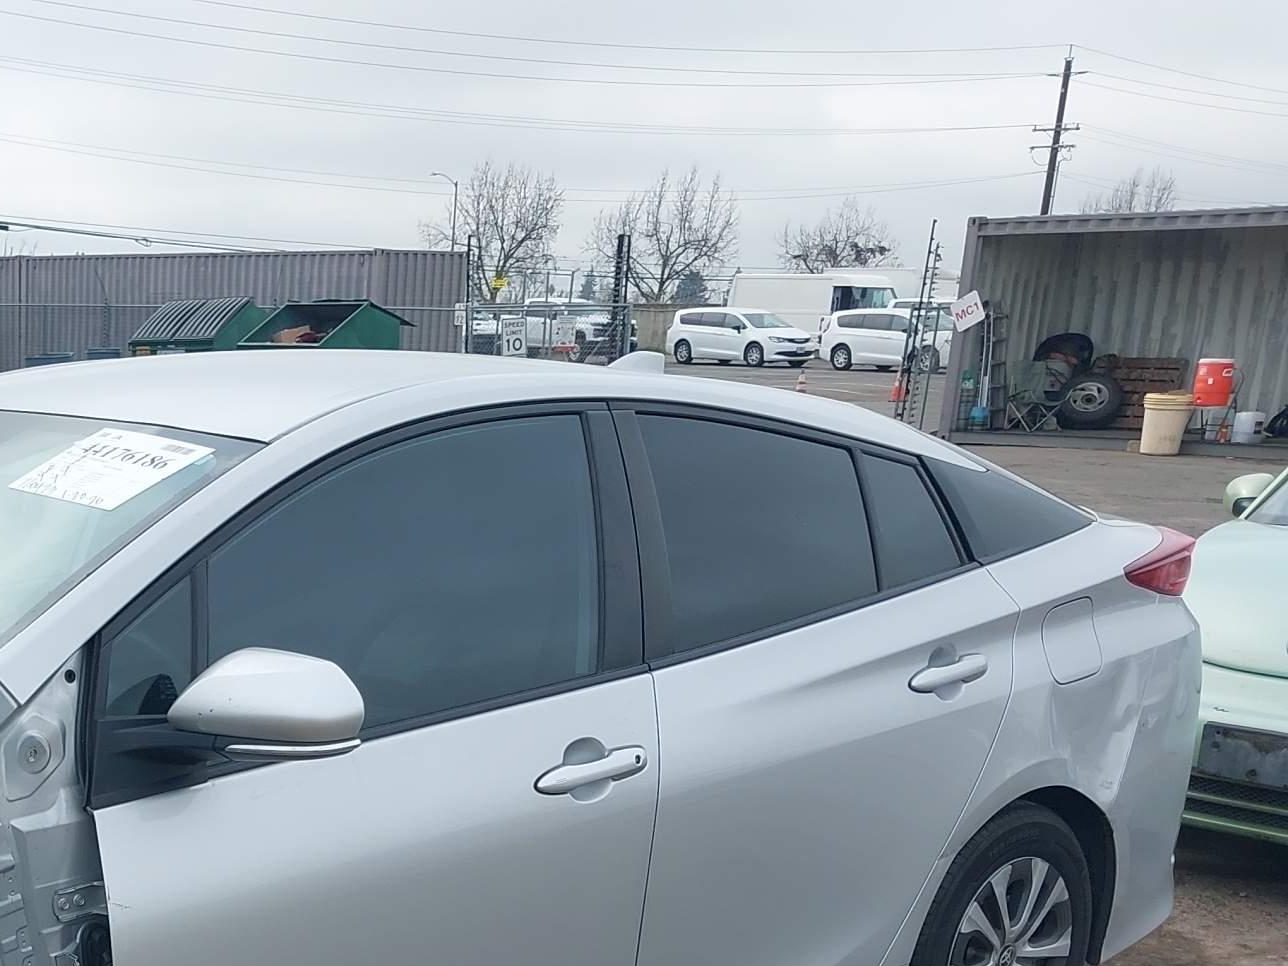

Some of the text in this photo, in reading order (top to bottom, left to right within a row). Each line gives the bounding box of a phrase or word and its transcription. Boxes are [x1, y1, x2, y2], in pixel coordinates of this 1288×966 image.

[955, 302, 979, 322] MC1
[505, 337, 523, 352] 10
[80, 442, 176, 469] 44176186
